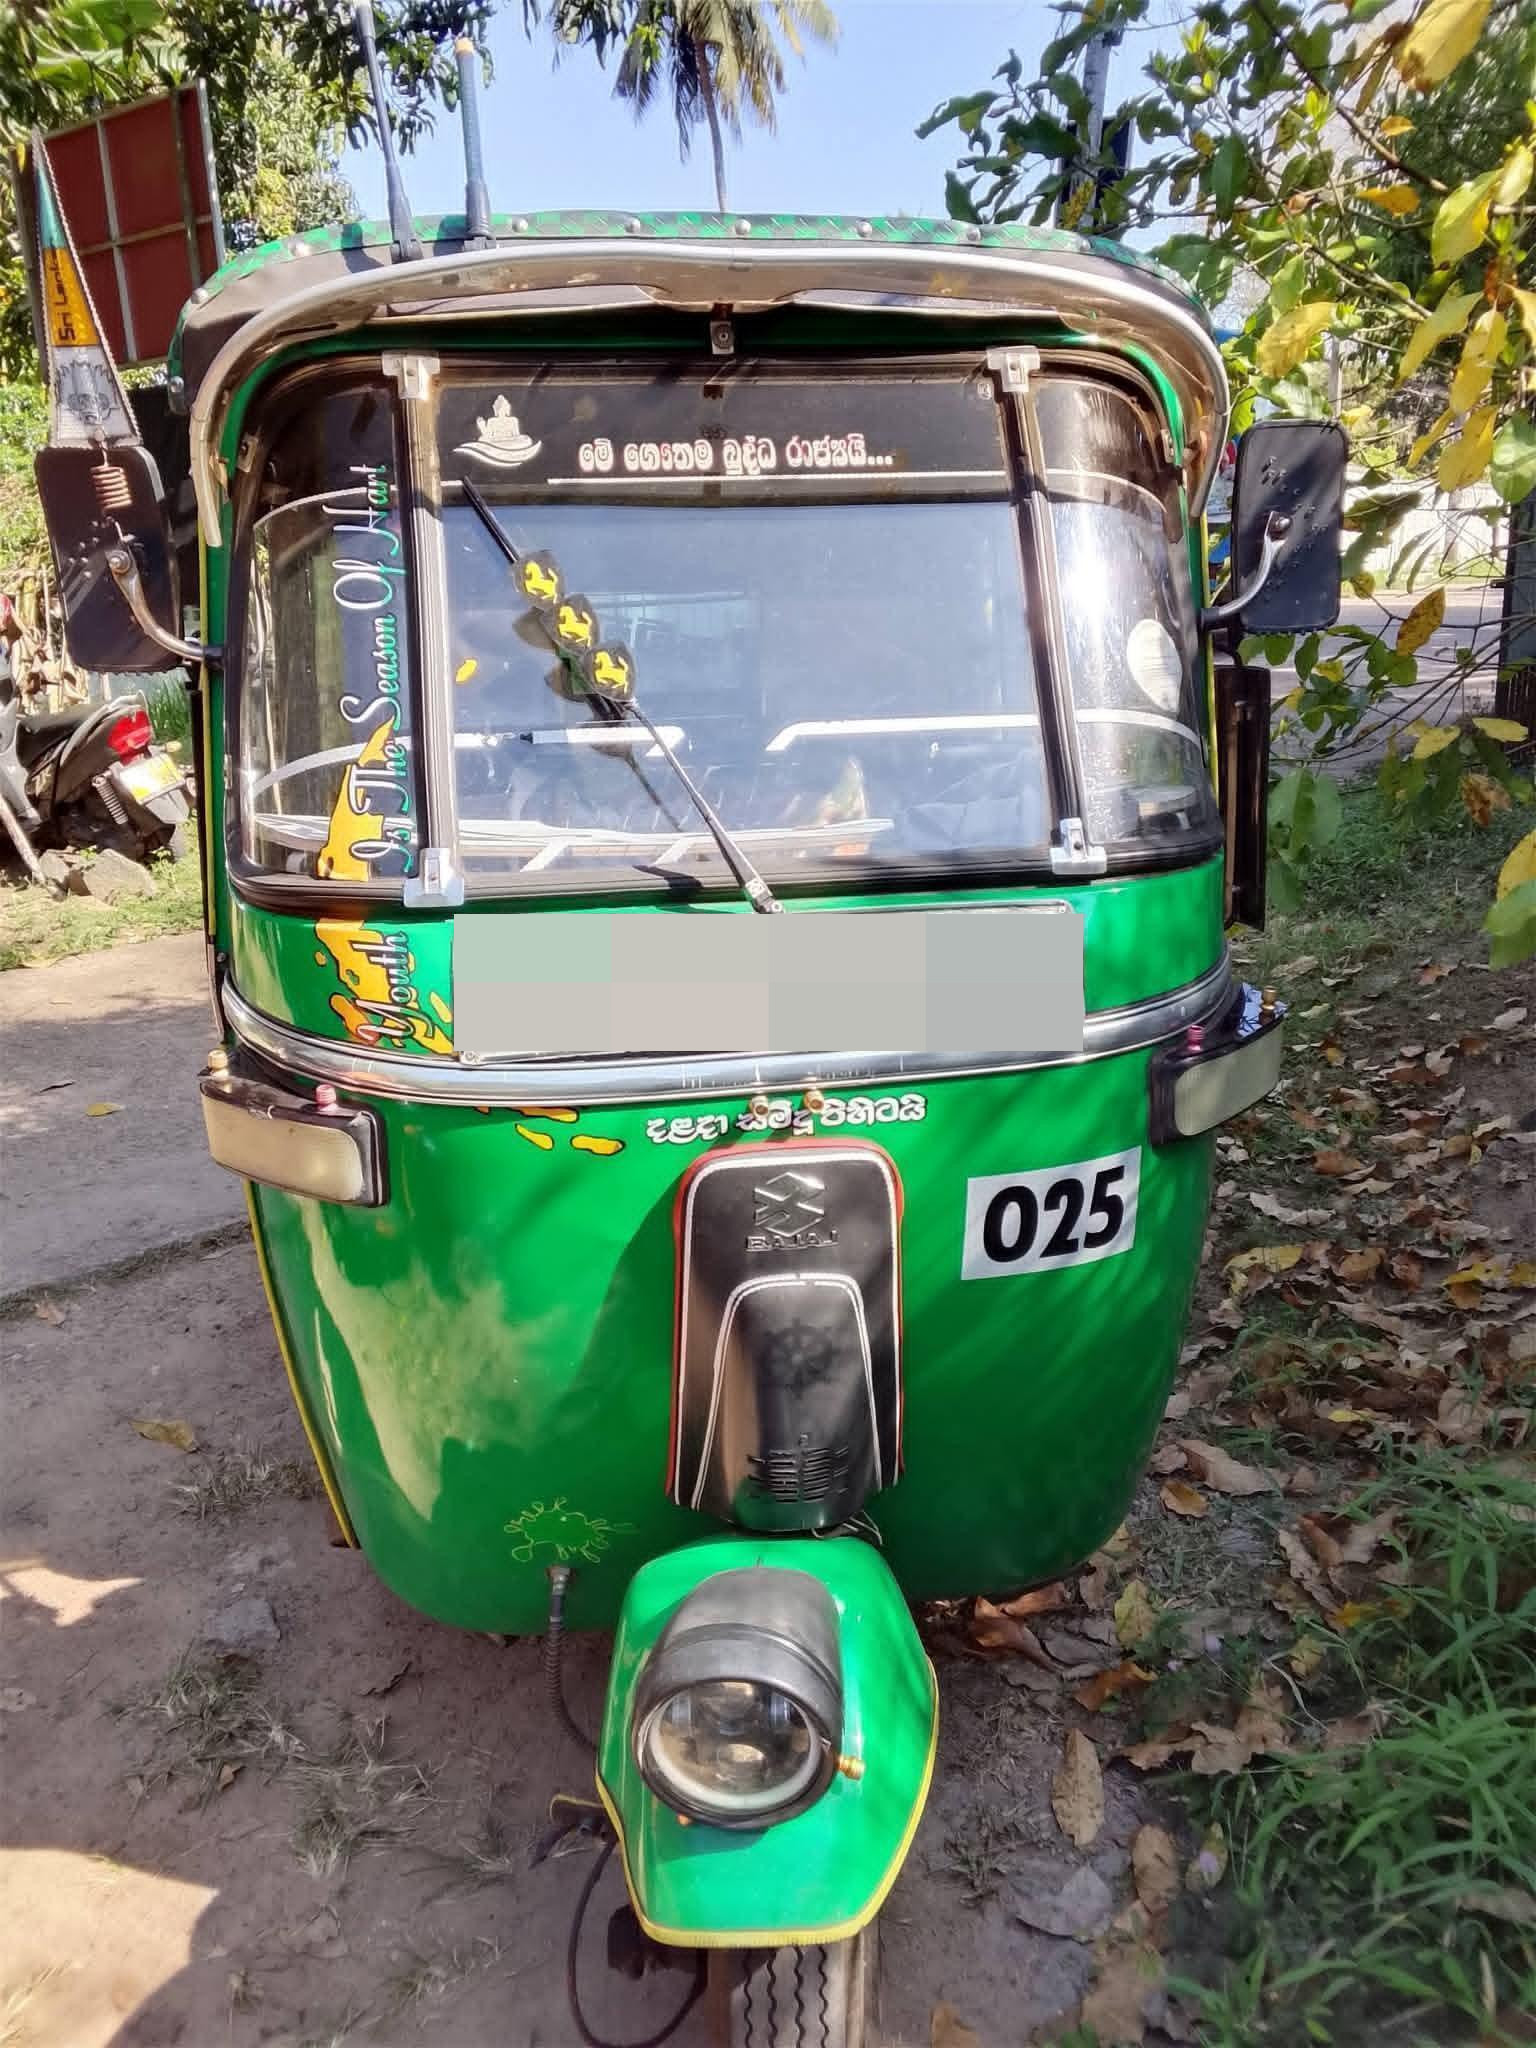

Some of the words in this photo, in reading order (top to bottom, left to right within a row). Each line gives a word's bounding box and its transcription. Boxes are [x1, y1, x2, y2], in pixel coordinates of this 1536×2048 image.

[57, 312, 76, 341] Sri
[578, 437, 615, 472] මේ
[722, 434, 777, 476] බුද්ධ
[321, 464, 400, 557] Hart
[332, 559, 406, 610] Of
[339, 613, 401, 732] Season
[348, 740, 410, 814] The
[349, 828, 413, 874] Is
[356, 931, 434, 1041] Youth
[645, 1113, 729, 1144] දළදා
[983, 1165, 1125, 1263] 025
[745, 1228, 840, 1253] BAJAJ
